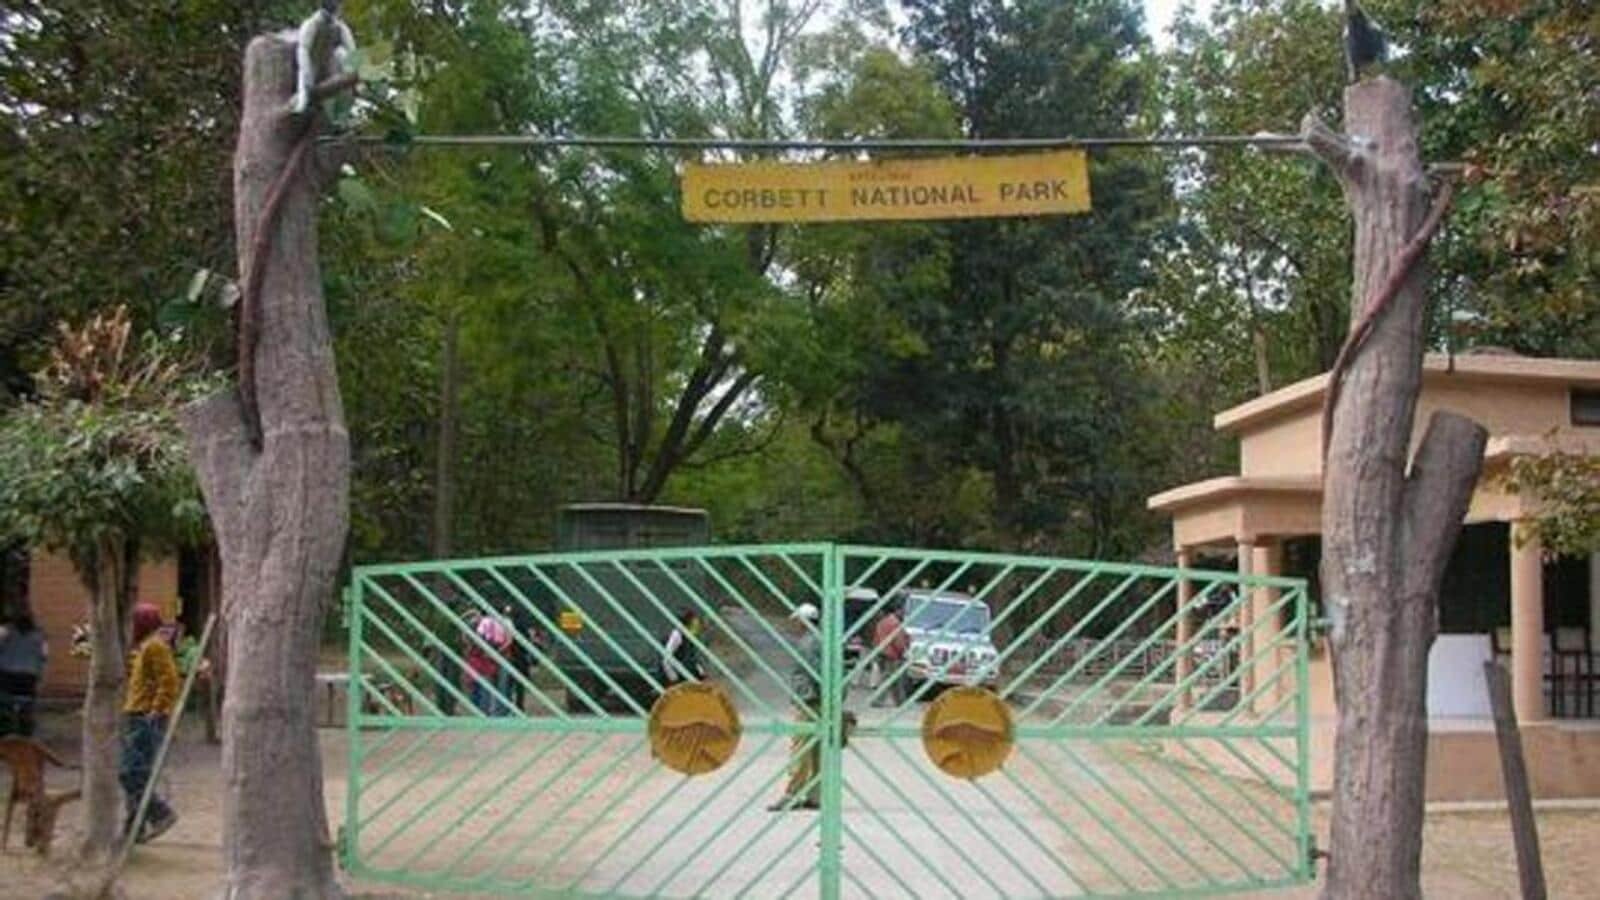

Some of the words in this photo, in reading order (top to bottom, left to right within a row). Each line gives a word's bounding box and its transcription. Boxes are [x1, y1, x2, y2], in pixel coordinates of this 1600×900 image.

[704, 187, 827, 210] CORBETT
[852, 183, 979, 207] NATIONAL
[1000, 179, 1069, 203] PARK
